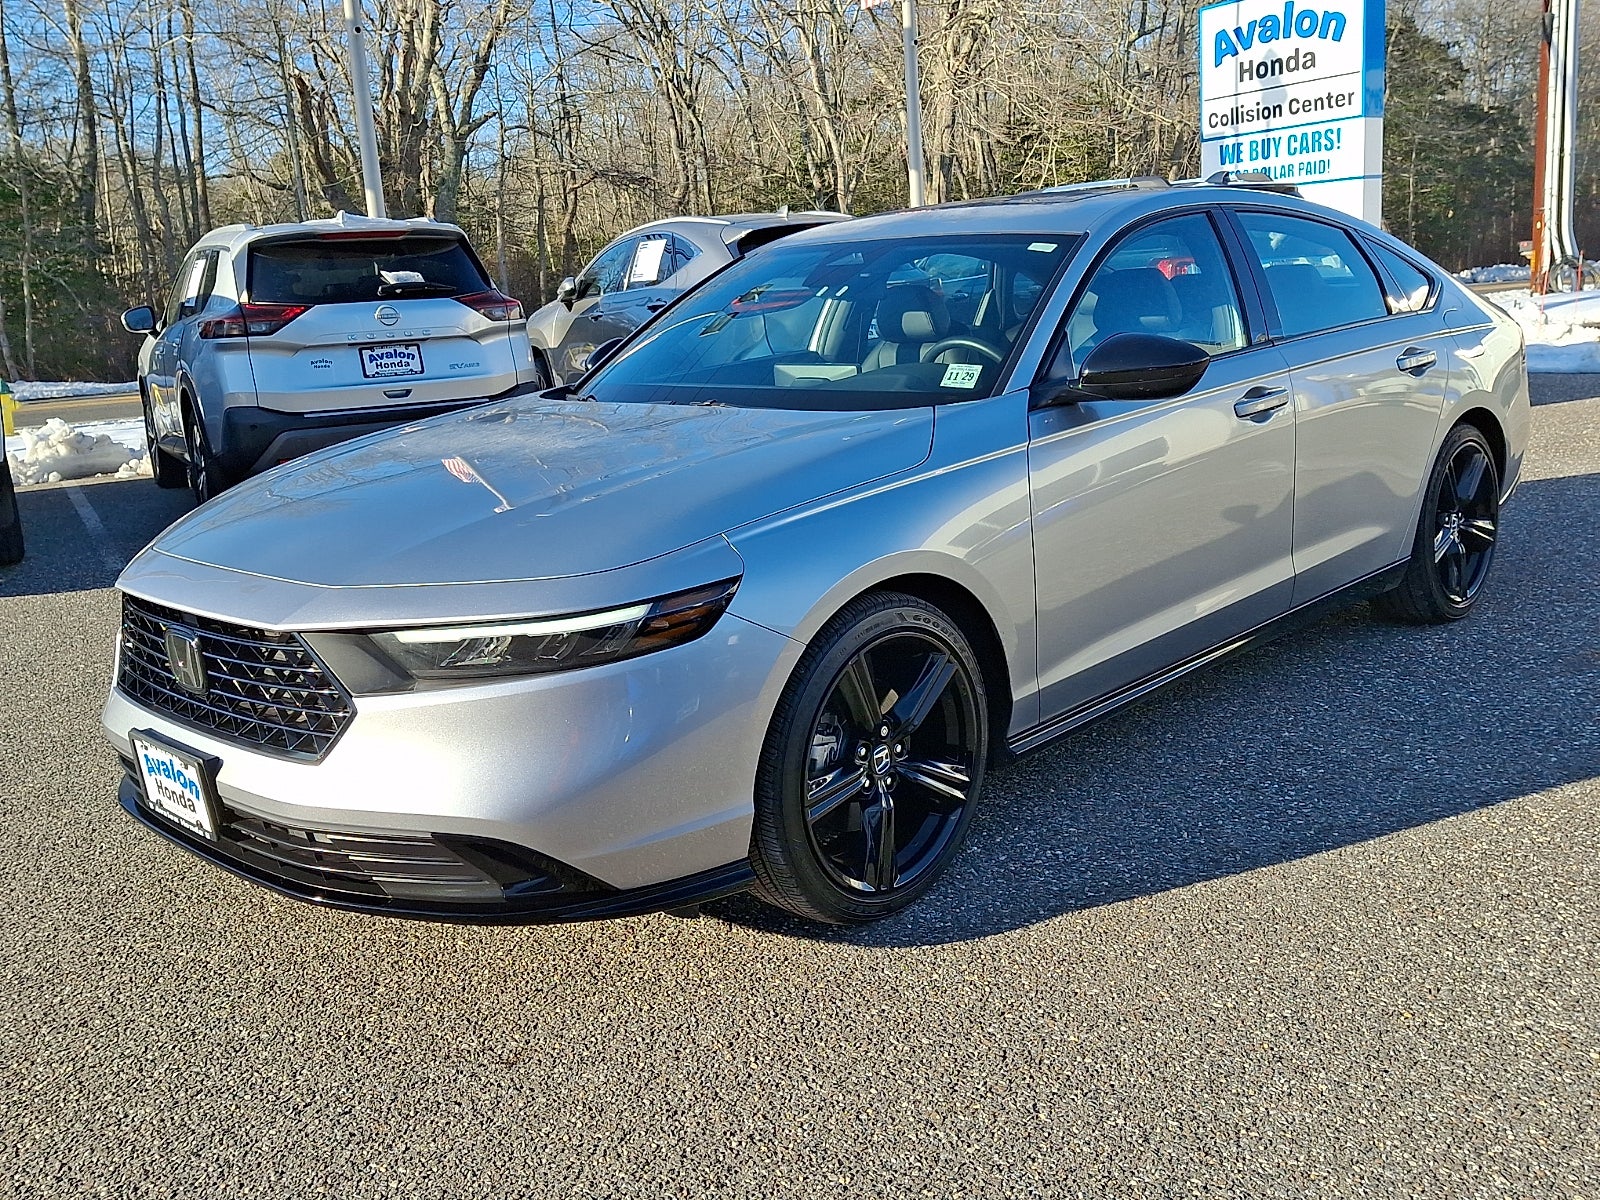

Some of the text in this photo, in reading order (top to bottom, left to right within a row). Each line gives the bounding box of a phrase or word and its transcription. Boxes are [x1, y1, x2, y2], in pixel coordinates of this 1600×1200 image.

[1214, 1, 1347, 68] Avalon
[1239, 47, 1316, 83] Honda
[1208, 91, 1355, 129] Collision Center
[1219, 127, 1342, 166] WE BUY CARS!
[1298, 158, 1330, 177] PAID!
[368, 348, 416, 365] Avalon
[374, 360, 411, 370] Honda
[947, 371, 975, 382] 11 29
[143, 753, 201, 802] Avalon
[155, 777, 198, 814] Honda
